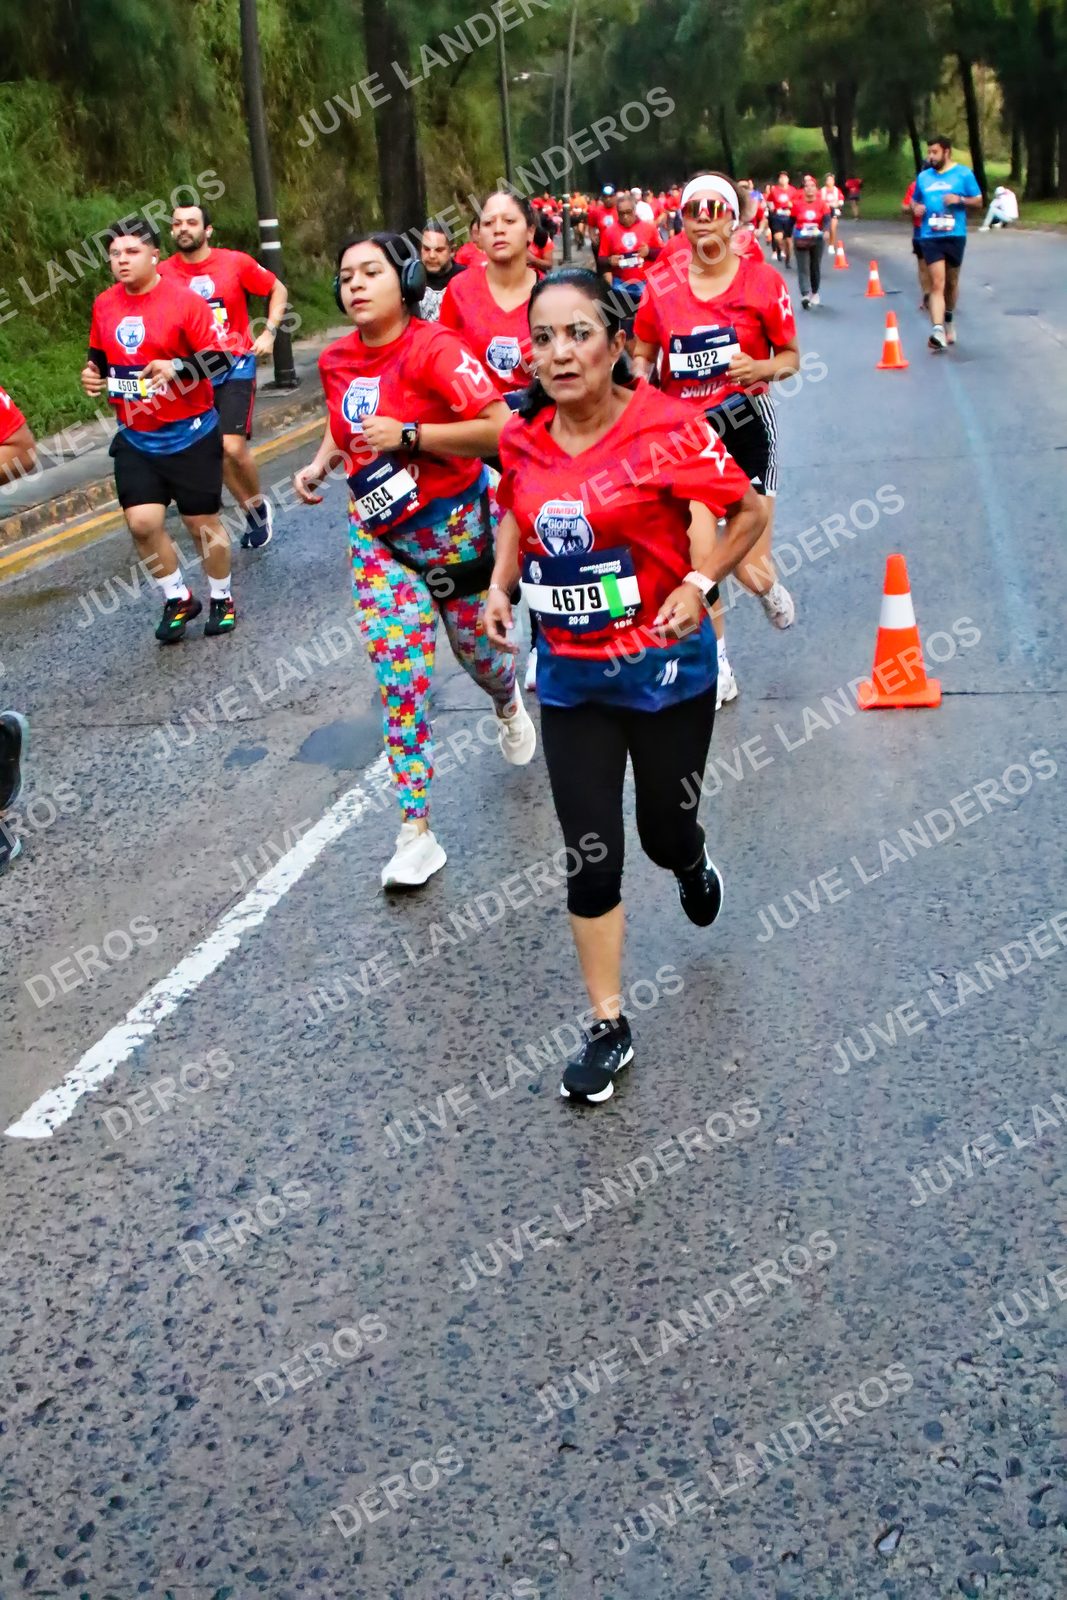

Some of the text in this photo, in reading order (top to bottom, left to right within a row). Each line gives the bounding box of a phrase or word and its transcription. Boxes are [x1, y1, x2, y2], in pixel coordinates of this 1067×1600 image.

[687, 350, 719, 369] 4922
[360, 486, 394, 515] 5264
[546, 507, 577, 515] BIMBO
[548, 518, 577, 530] Global
[544, 527, 568, 538] Race
[551, 585, 602, 611] 4679
